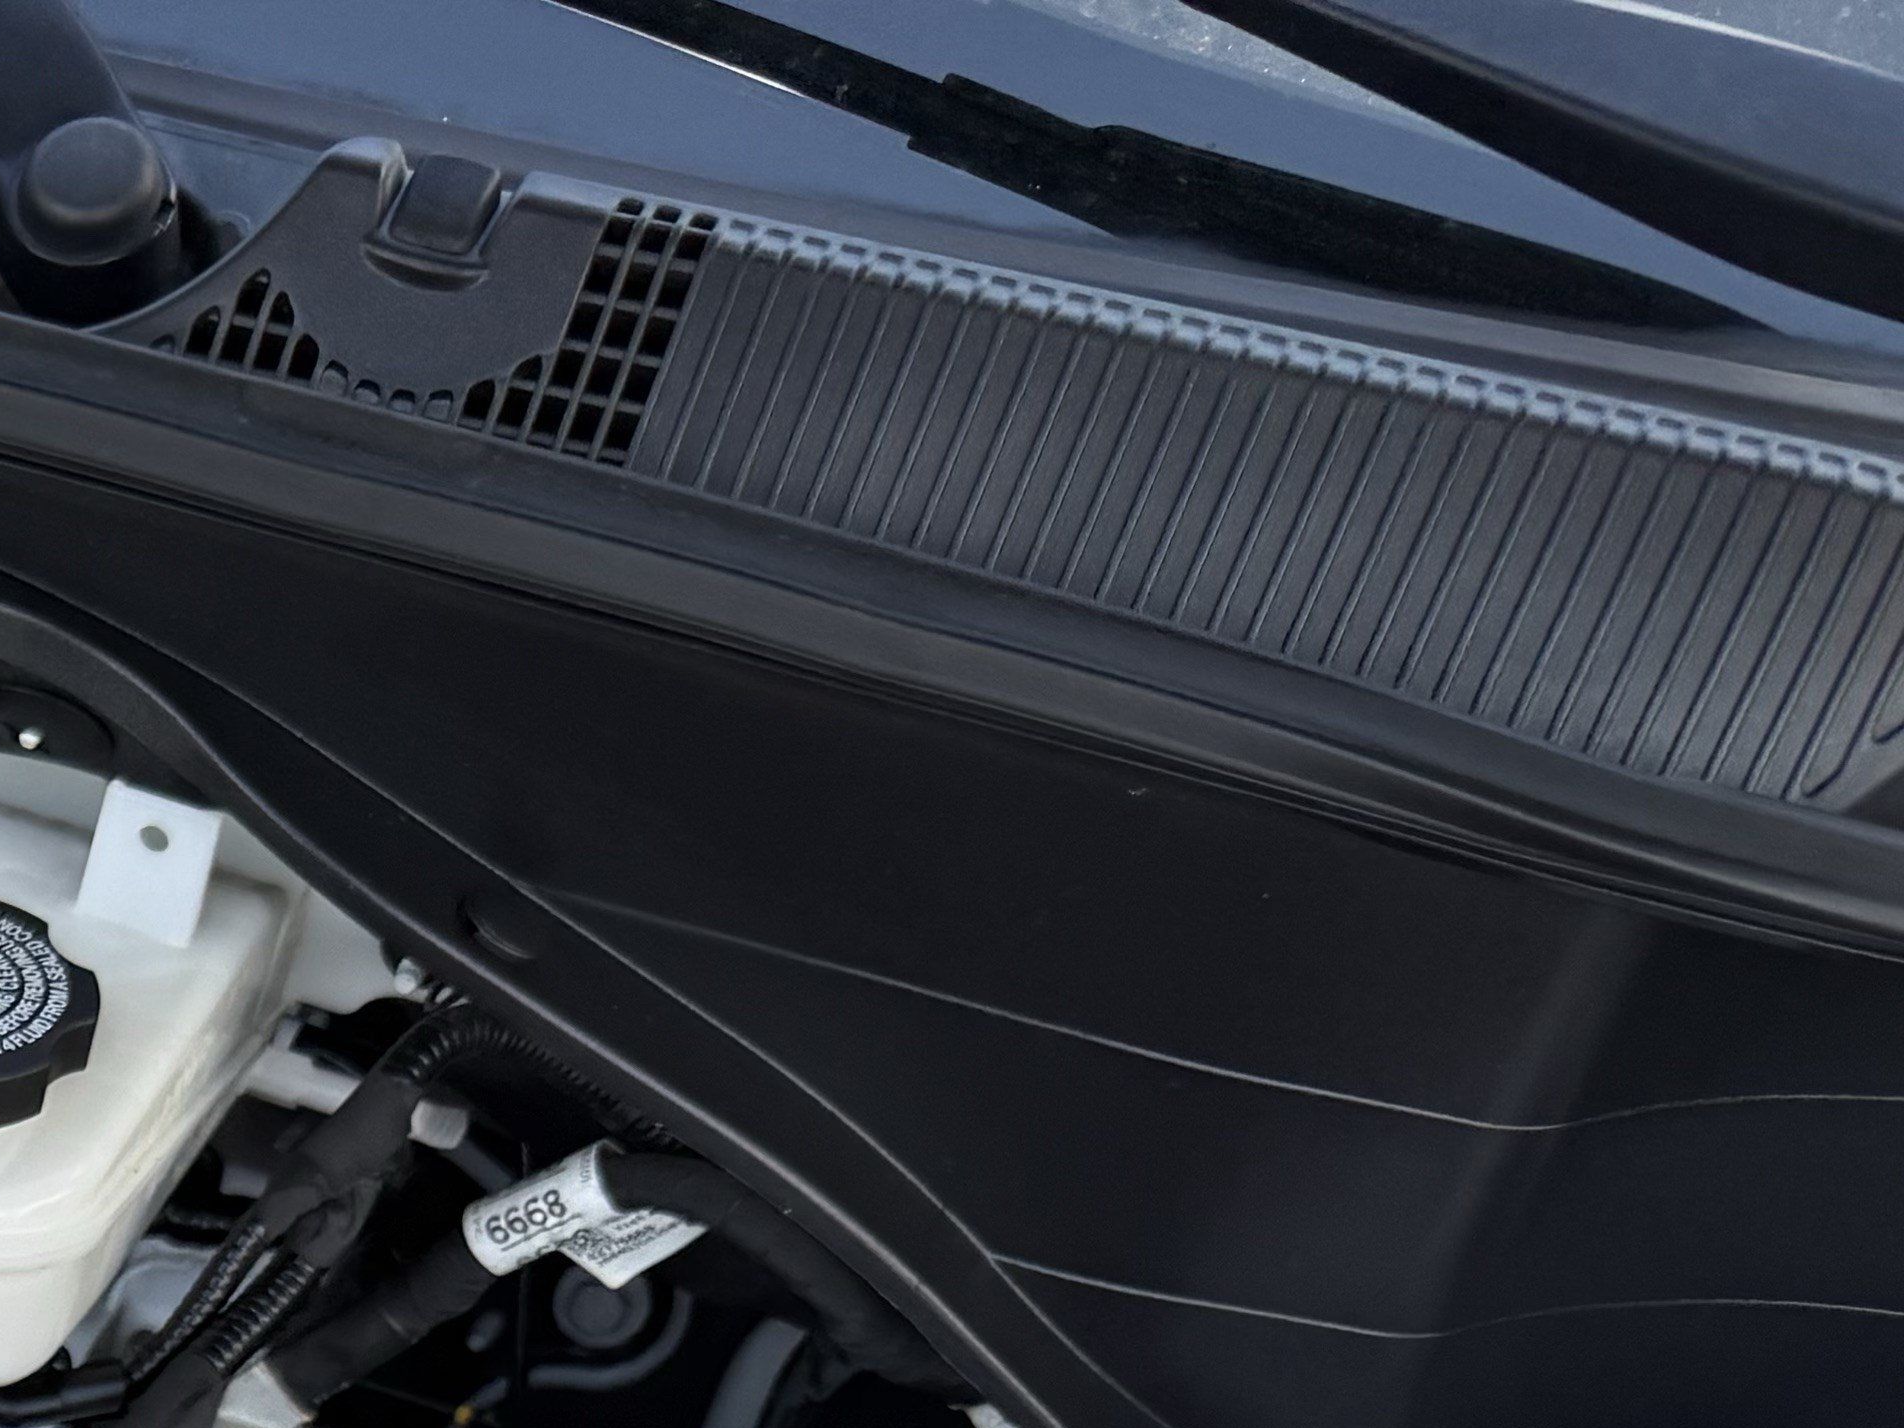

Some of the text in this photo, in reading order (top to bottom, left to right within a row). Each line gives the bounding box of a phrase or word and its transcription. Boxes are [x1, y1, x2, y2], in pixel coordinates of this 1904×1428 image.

[23, 937, 68, 980] SEALED
[36, 989, 69, 1022] FROM
[6, 1017, 54, 1047] FLUID
[486, 1188, 568, 1246] 6668
